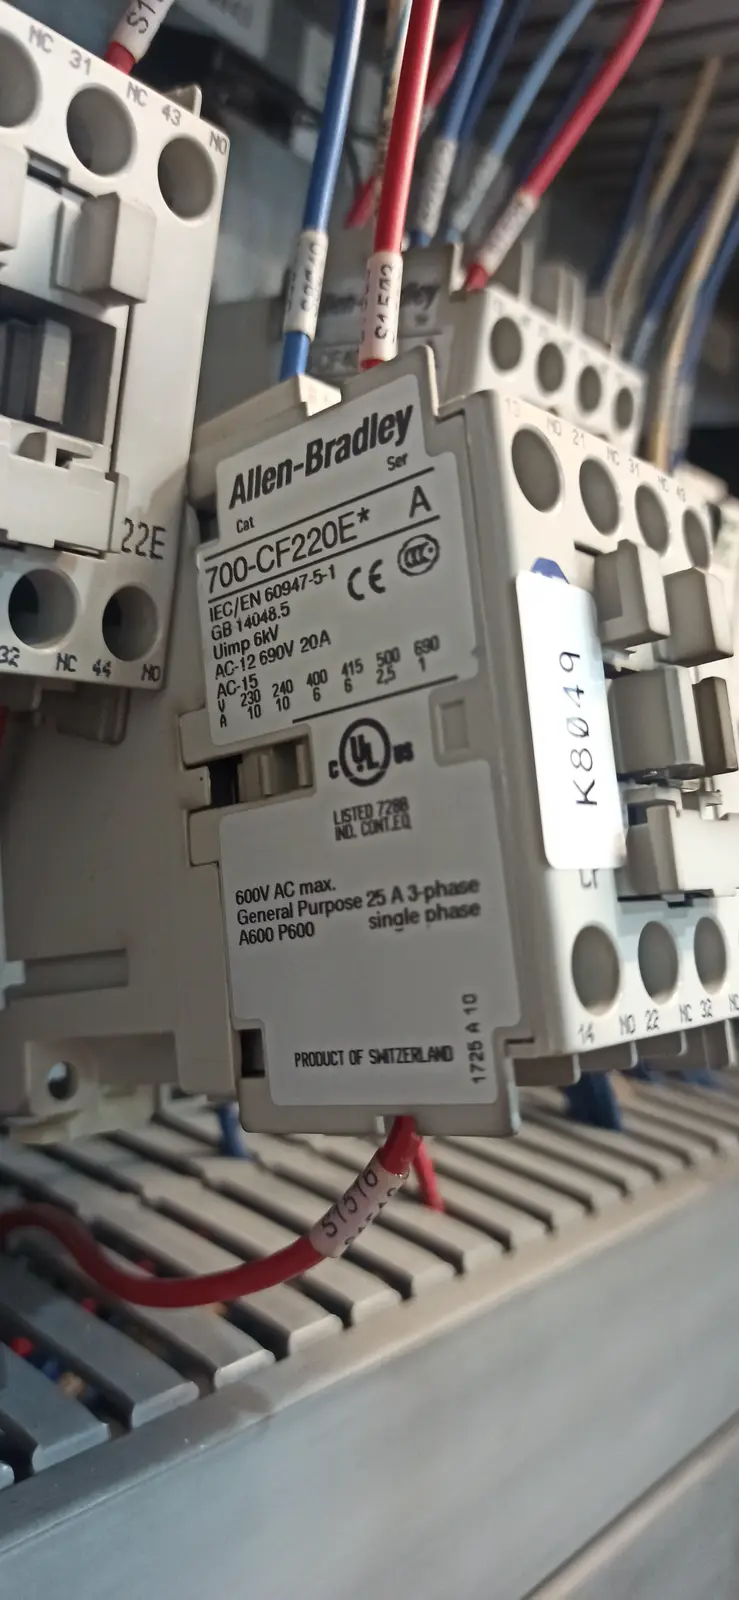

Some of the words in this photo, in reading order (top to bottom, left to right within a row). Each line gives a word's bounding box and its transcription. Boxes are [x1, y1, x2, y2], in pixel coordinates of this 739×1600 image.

[28, 25, 54, 53] NC
[68, 49, 91, 76] 31
[126, 81, 149, 107] NC
[161, 104, 181, 126] 43
[209, 131, 227, 155] NO
[228, 404, 413, 510] Allen-Bradley
[546, 416, 562, 437] NO
[572, 428, 586, 447] 21
[627, 458, 640, 477] 31
[236, 516, 255, 534] Cat
[387, 453, 408, 472] Ser
[409, 485, 432, 518] A
[121, 517, 167, 560] 22E
[209, 592, 261, 622] IEC/EN
[265, 564, 335, 602] 60947-5-1
[211, 621, 233, 641] GB
[236, 601, 290, 632] 14048.5
[213, 638, 251, 660] Uimp
[253, 624, 279, 646] 6kV
[215, 654, 256, 680] AC-12
[259, 639, 294, 665] 690V
[300, 629, 331, 653] 20A
[0, 645, 20, 668] 32
[56, 652, 78, 673] NC
[92, 659, 112, 678] 44
[140, 663, 161, 682] NO
[217, 698, 226, 713] V
[240, 689, 261, 707] 230
[272, 679, 293, 698] 240
[306, 668, 328, 687] 400
[341, 658, 364, 678] 415
[375, 647, 401, 668] 500
[414, 635, 440, 656] 690
[217, 673, 258, 699] AC-15
[220, 714, 227, 728] A
[247, 705, 262, 720] 10
[276, 697, 290, 712] 10
[313, 687, 321, 702] 6
[344, 678, 352, 693] 6
[375, 666, 396, 685] 2,5
[418, 657, 427, 672] 1
[559, 651, 598, 806] K8049
[333, 803, 373, 825] LISTED
[334, 824, 358, 841] IND.
[235, 885, 270, 906] 600V
[274, 881, 295, 898] AC
[299, 878, 336, 896] max.
[237, 902, 294, 926] General
[297, 893, 363, 918] Purpose
[366, 889, 387, 908] 25
[390, 885, 404, 904] A
[407, 878, 481, 904] 3-phase
[238, 926, 274, 946] A600
[278, 921, 315, 941] P600
[368, 908, 421, 932] single
[425, 900, 482, 926] phase
[462, 993, 478, 1015] 10
[578, 1023, 595, 1043] 14
[618, 1014, 636, 1035] NO
[644, 1009, 659, 1031] 22
[679, 1003, 693, 1024] NC
[699, 998, 713, 1018] 32
[465, 1022, 481, 1033] A
[294, 1050, 344, 1068] PRODUCT
[349, 1049, 364, 1065] OF
[368, 1045, 454, 1065] SWITZERLAND
[467, 1040, 486, 1084] 1725
